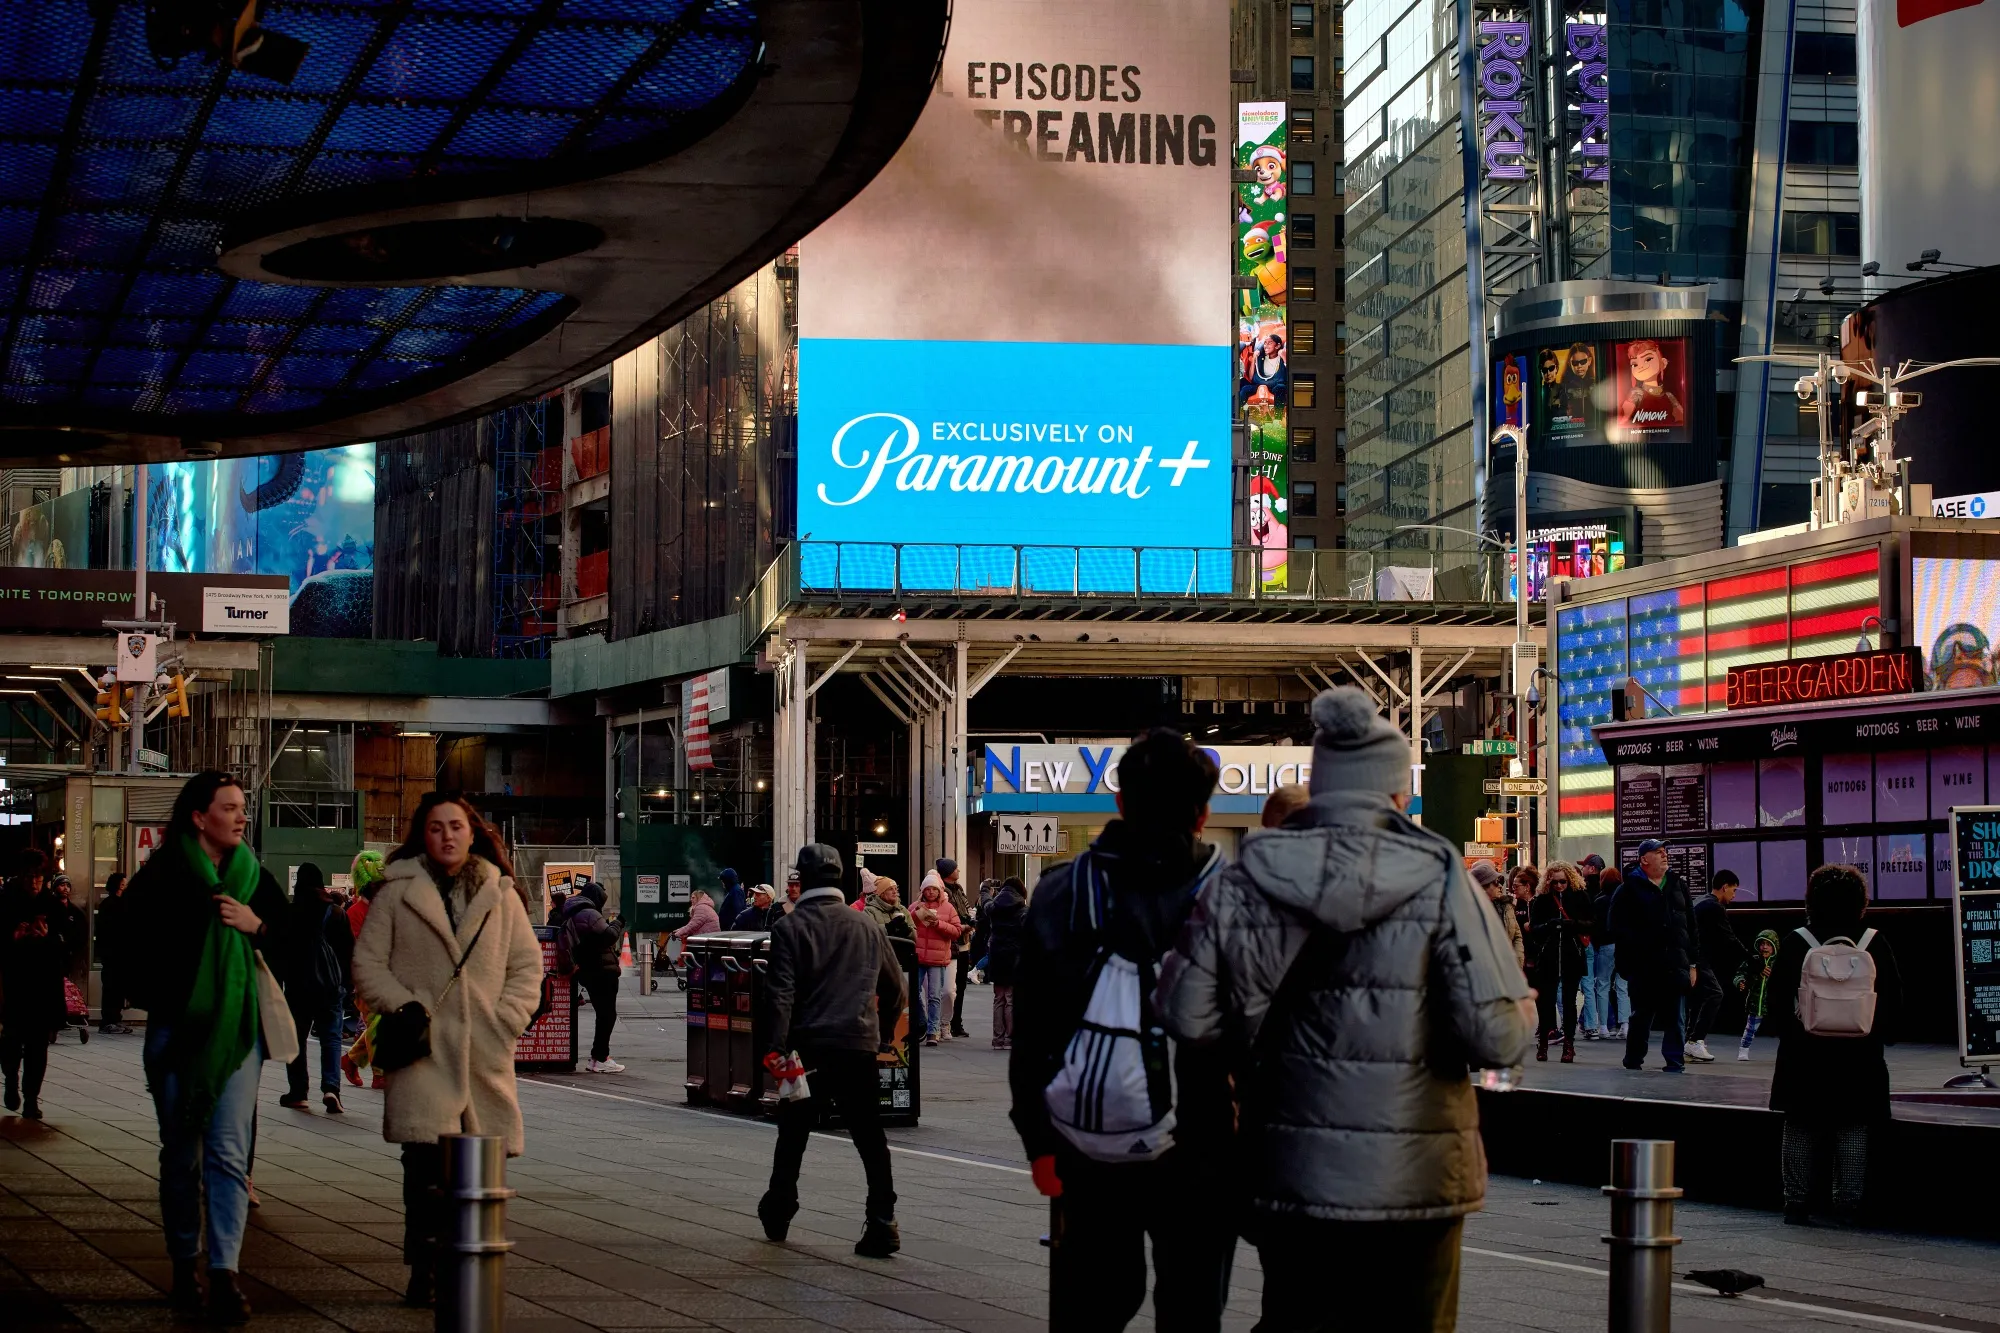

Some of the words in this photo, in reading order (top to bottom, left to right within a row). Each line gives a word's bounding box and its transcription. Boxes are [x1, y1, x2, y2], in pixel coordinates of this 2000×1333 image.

[968, 61, 1141, 102] EPISODES
[1479, 21, 1529, 179] ROKU
[974, 109, 1217, 167] TREAMING
[1632, 408, 1669, 424] NIMONA
[932, 421, 1087, 443] EXCLUSIVELY
[1098, 424, 1134, 444] ON
[1262, 451, 1283, 462] DINE
[1935, 501, 1967, 518] ASE
[1526, 528, 1539, 543] LL
[1538, 526, 1582, 543] TOGETHER
[1583, 524, 1607, 540] NOW
[0, 588, 31, 600] RITE
[38, 590, 132, 603] TOMORROW
[224, 605, 269, 620] Turner
[1856, 722, 1900, 737] HOTDOGS
[1916, 718, 1939, 732] BEER
[1955, 715, 1981, 729] WINE
[1484, 743, 1493, 752] W
[1496, 742, 1507, 753] 43
[1617, 743, 1652, 756] HOTDOGS
[1665, 740, 1684, 753] BEER
[1697, 737, 1719, 750] WINE
[985, 745, 1073, 793] NEW
[1078, 746, 1121, 793] YO
[1202, 748, 1312, 794] OLICE
[1828, 780, 1867, 793] HOTDOGS
[1887, 777, 1915, 790] BEER
[1943, 773, 1973, 786] WINE
[1486, 783, 1500, 791] ONE
[1529, 783, 1544, 791] WAY
[74, 796, 85, 855] Newsstand
[1973, 822, 2000, 840] SH
[1000, 843, 1017, 851] ONLY
[1967, 851, 1984, 859] THE
[1881, 860, 1923, 873] PRETZELS
[1937, 860, 1952, 872] LOBS
[548, 872, 570, 880] EXPLORE
[1966, 910, 1992, 921] OFFICIAL
[1972, 920, 1997, 931] HOLIDAY
